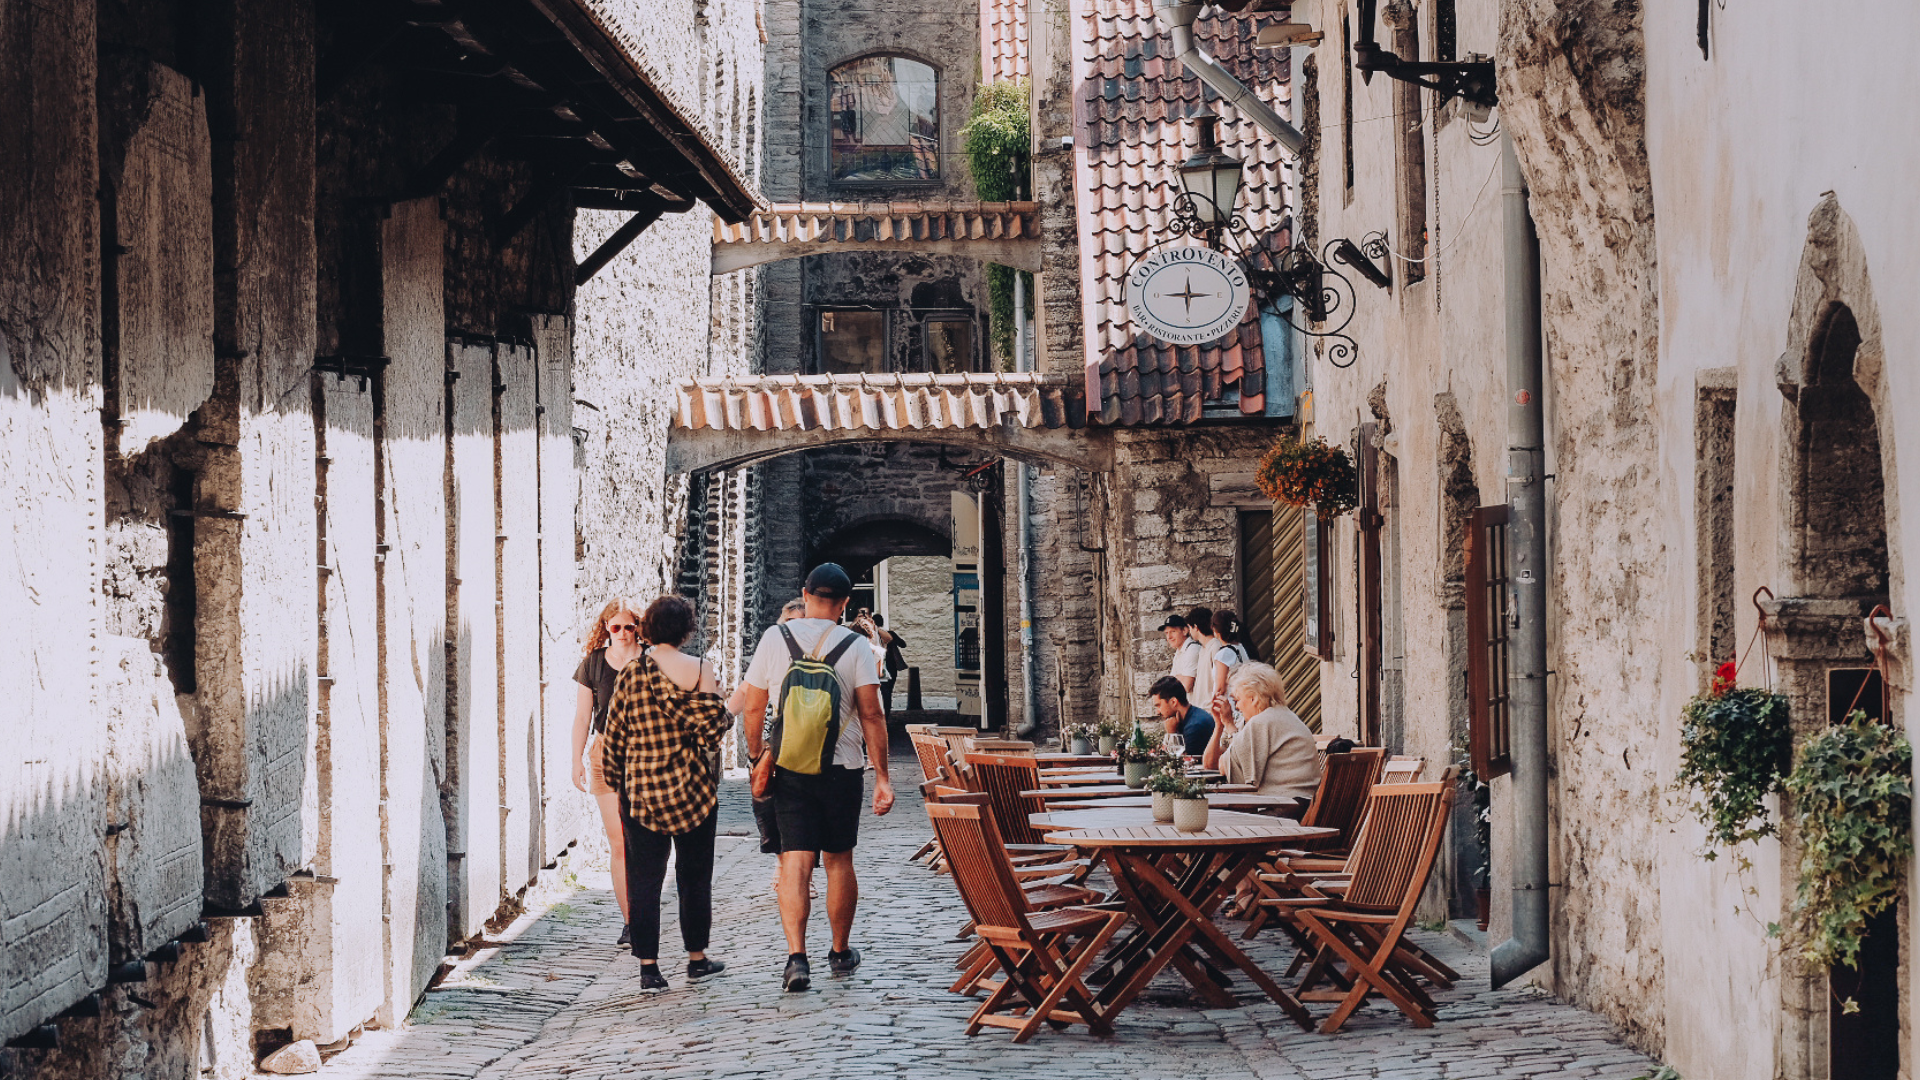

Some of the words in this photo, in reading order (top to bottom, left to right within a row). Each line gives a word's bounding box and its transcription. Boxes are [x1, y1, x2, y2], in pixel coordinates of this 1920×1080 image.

[1131, 248, 1244, 288] CONTROVENTO
[1133, 305, 1147, 323] BAR
[1148, 324, 1206, 341] RISTORANTE
[1211, 305, 1244, 335] PIZZERIA
